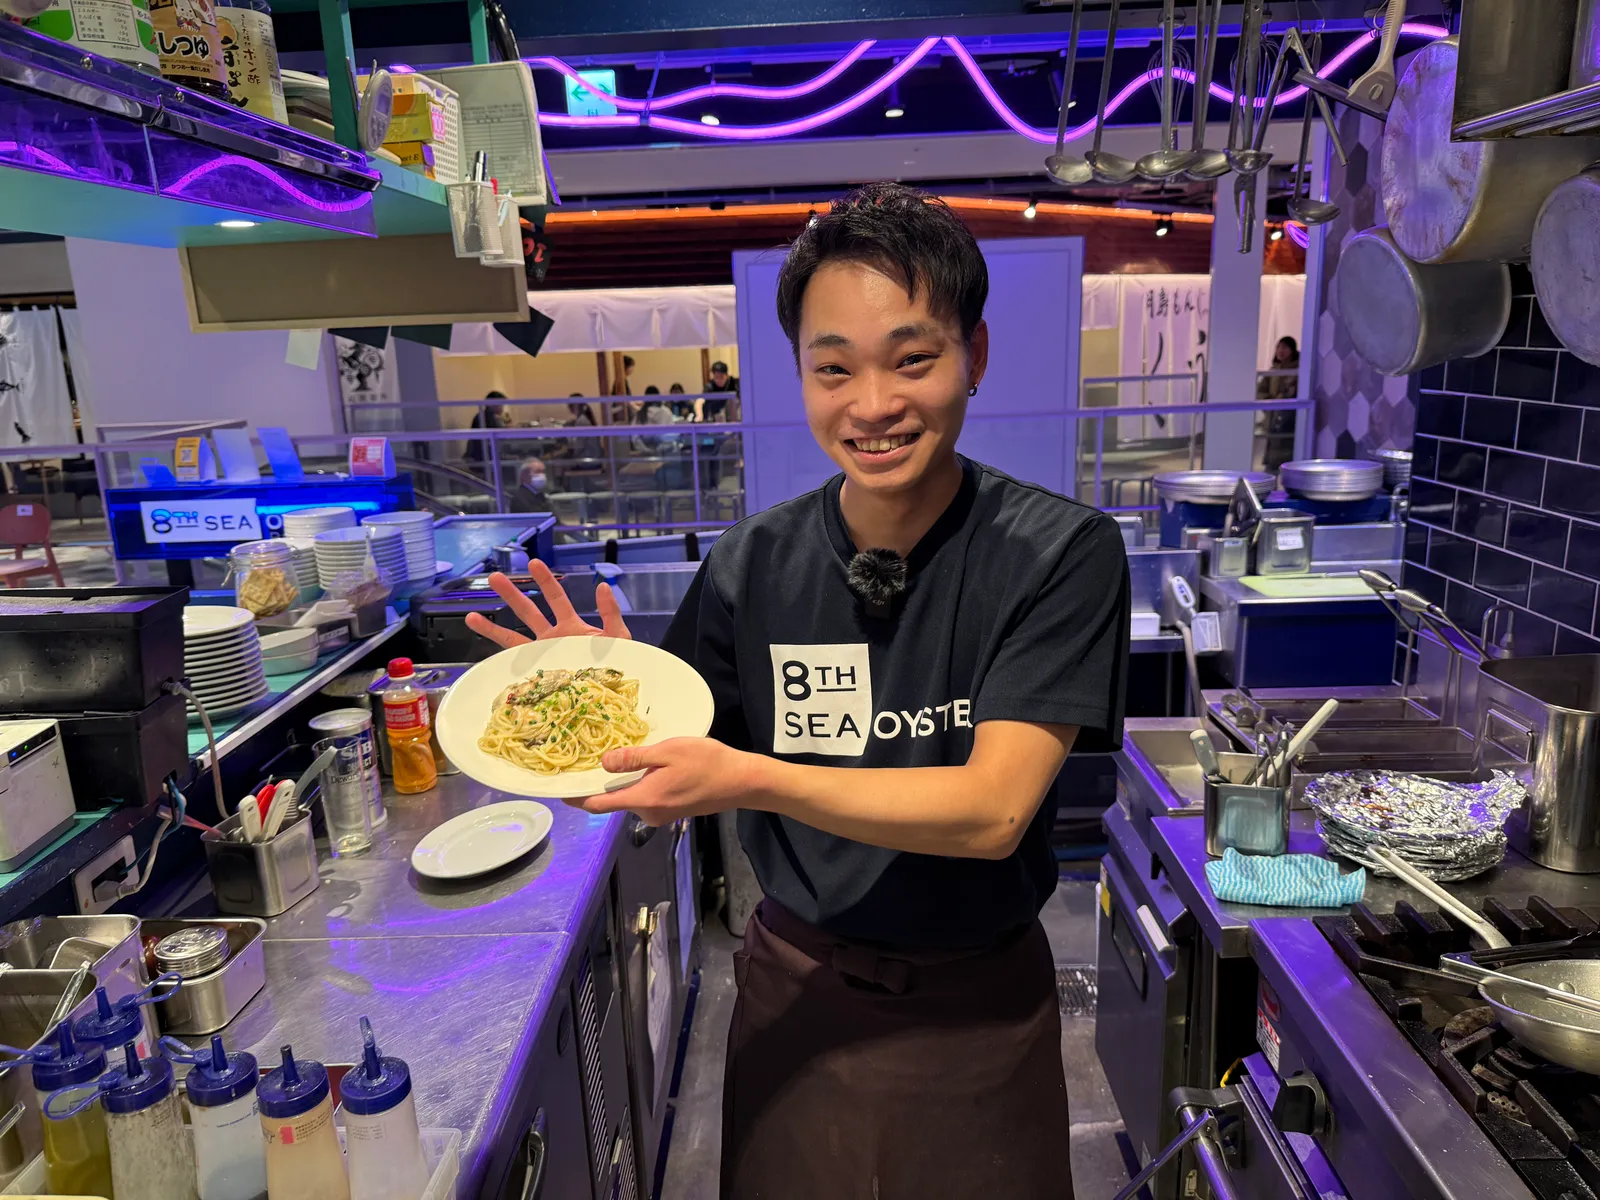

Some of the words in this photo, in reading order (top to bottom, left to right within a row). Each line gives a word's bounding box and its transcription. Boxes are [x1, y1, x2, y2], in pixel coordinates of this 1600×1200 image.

[157, 31, 210, 59] しつゆ
[151, 509, 199, 534] 8TH
[204, 515, 253, 531] SEA
[782, 660, 856, 702] 8TH
[785, 711, 862, 739] SEA
[873, 699, 973, 739] OYSTE
